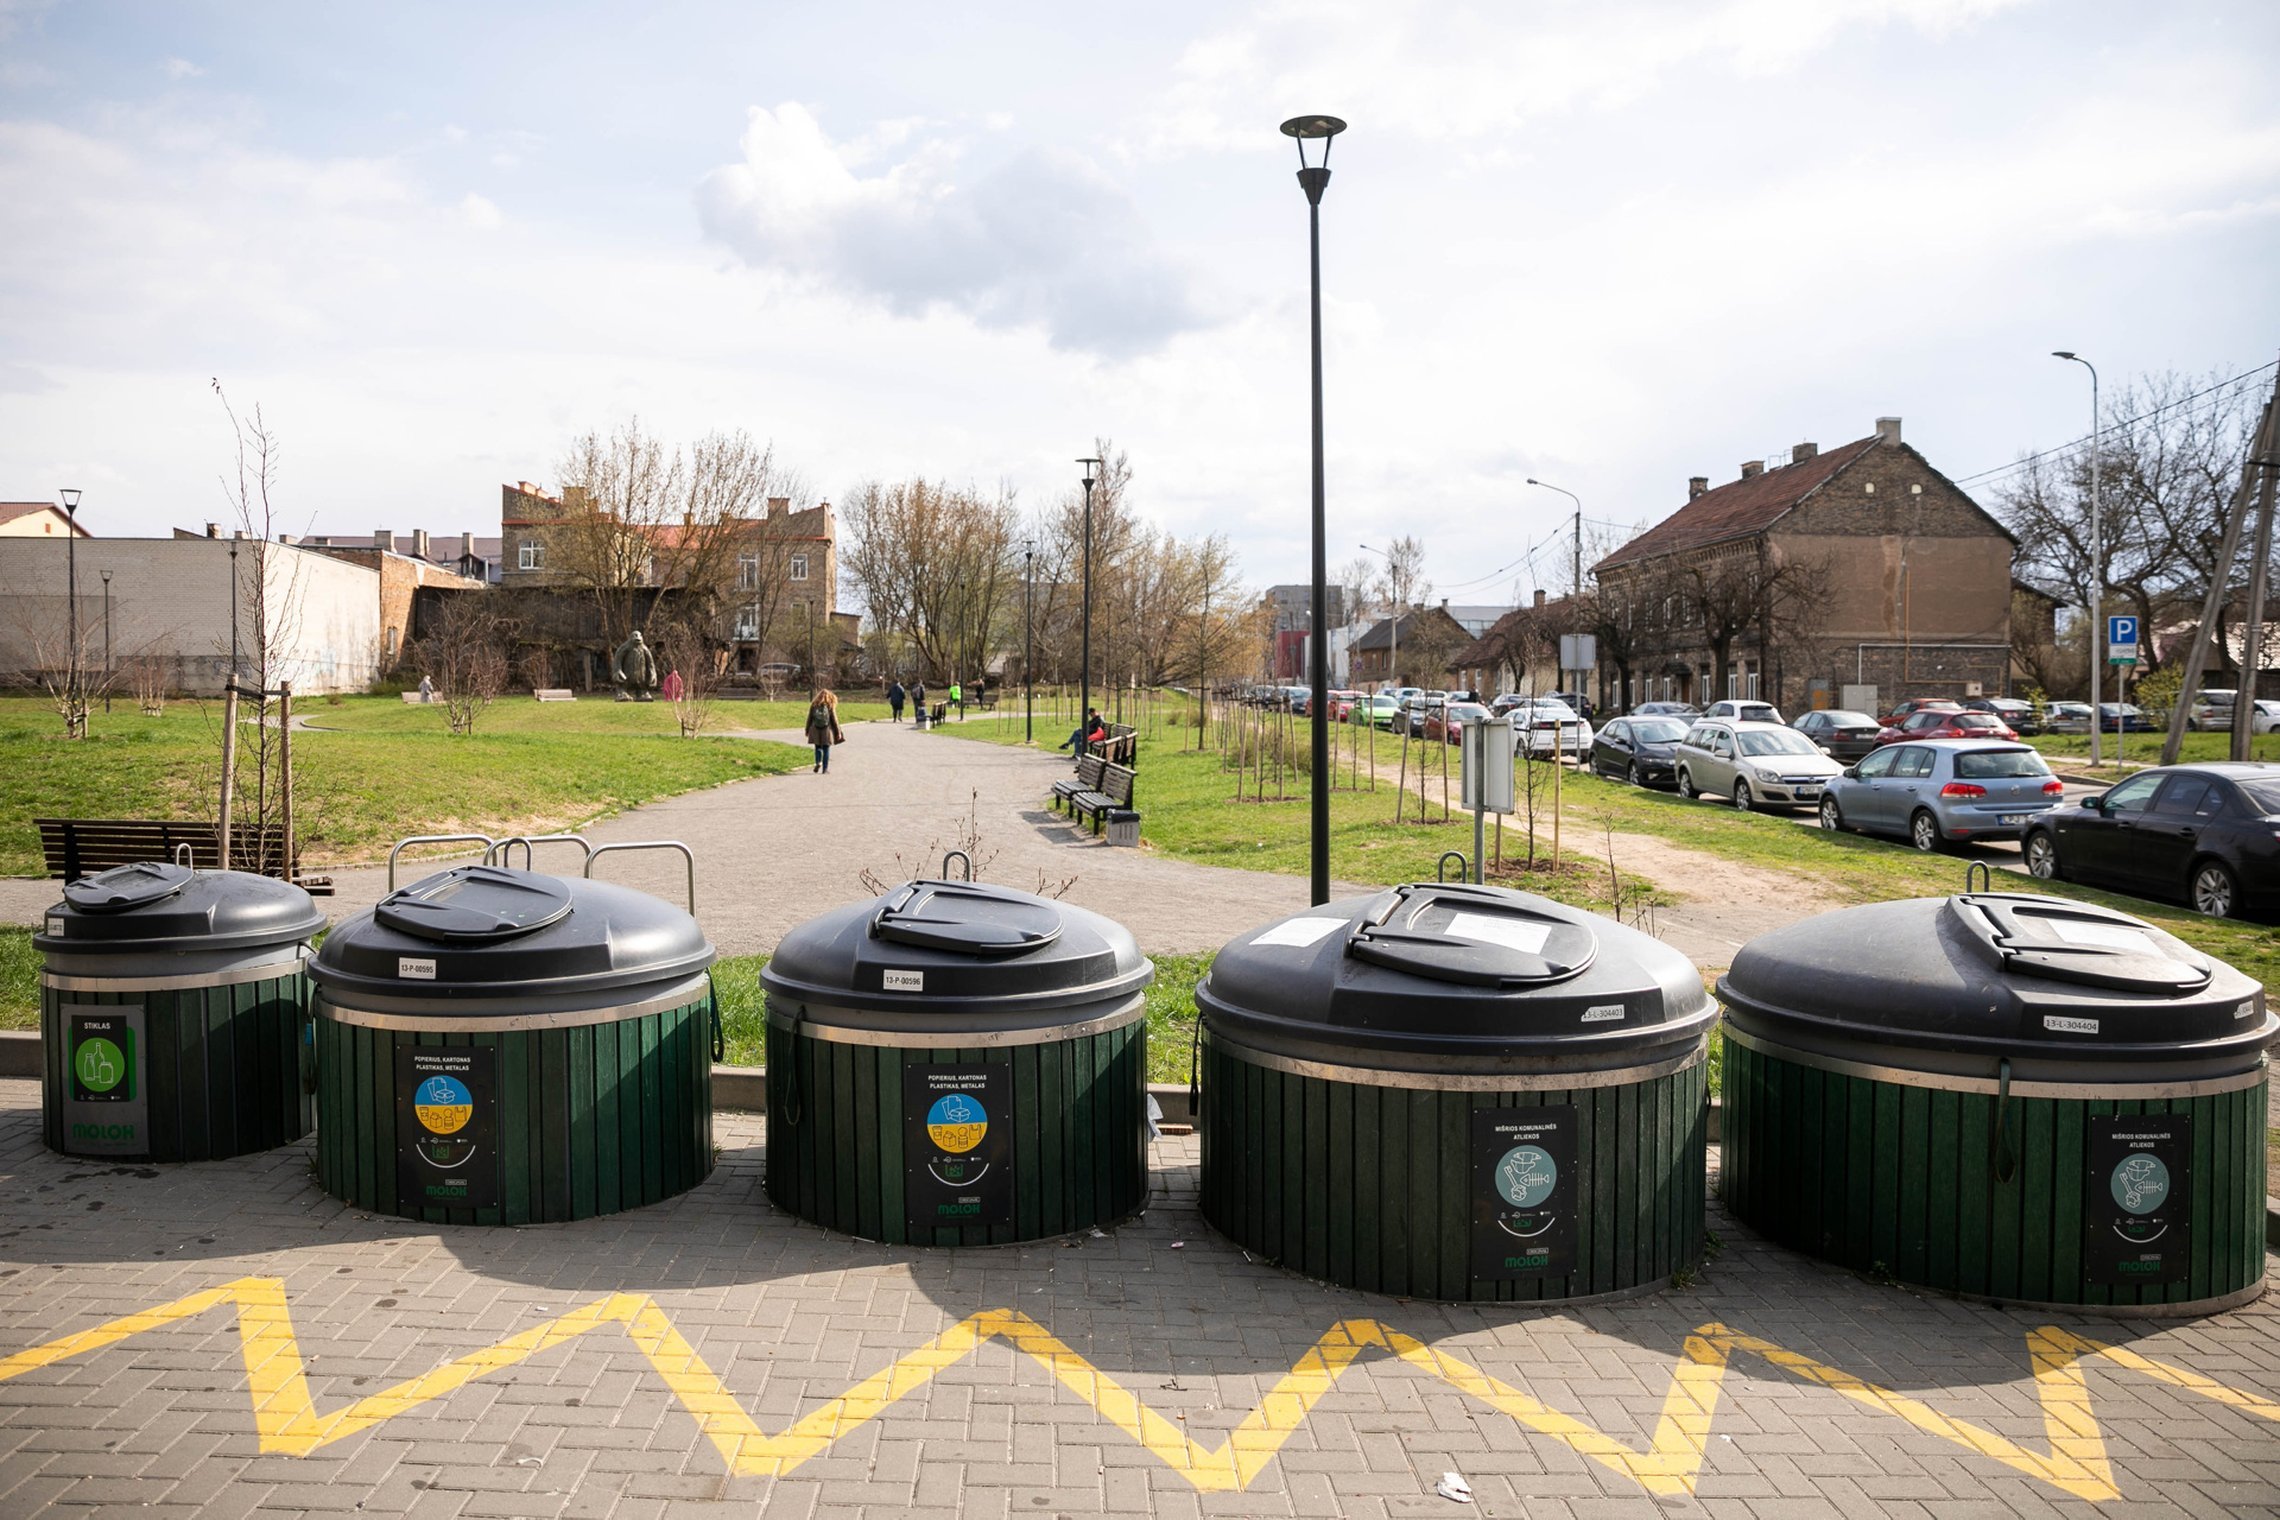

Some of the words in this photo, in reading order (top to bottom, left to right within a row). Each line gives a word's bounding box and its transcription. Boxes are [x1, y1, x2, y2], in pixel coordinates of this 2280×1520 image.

[2117, 620, 2132, 641] P
[401, 964, 434, 973] 13-P-00595
[886, 976, 921, 985] 13-P-00596
[2046, 1019, 2097, 1031] 13-L-304404
